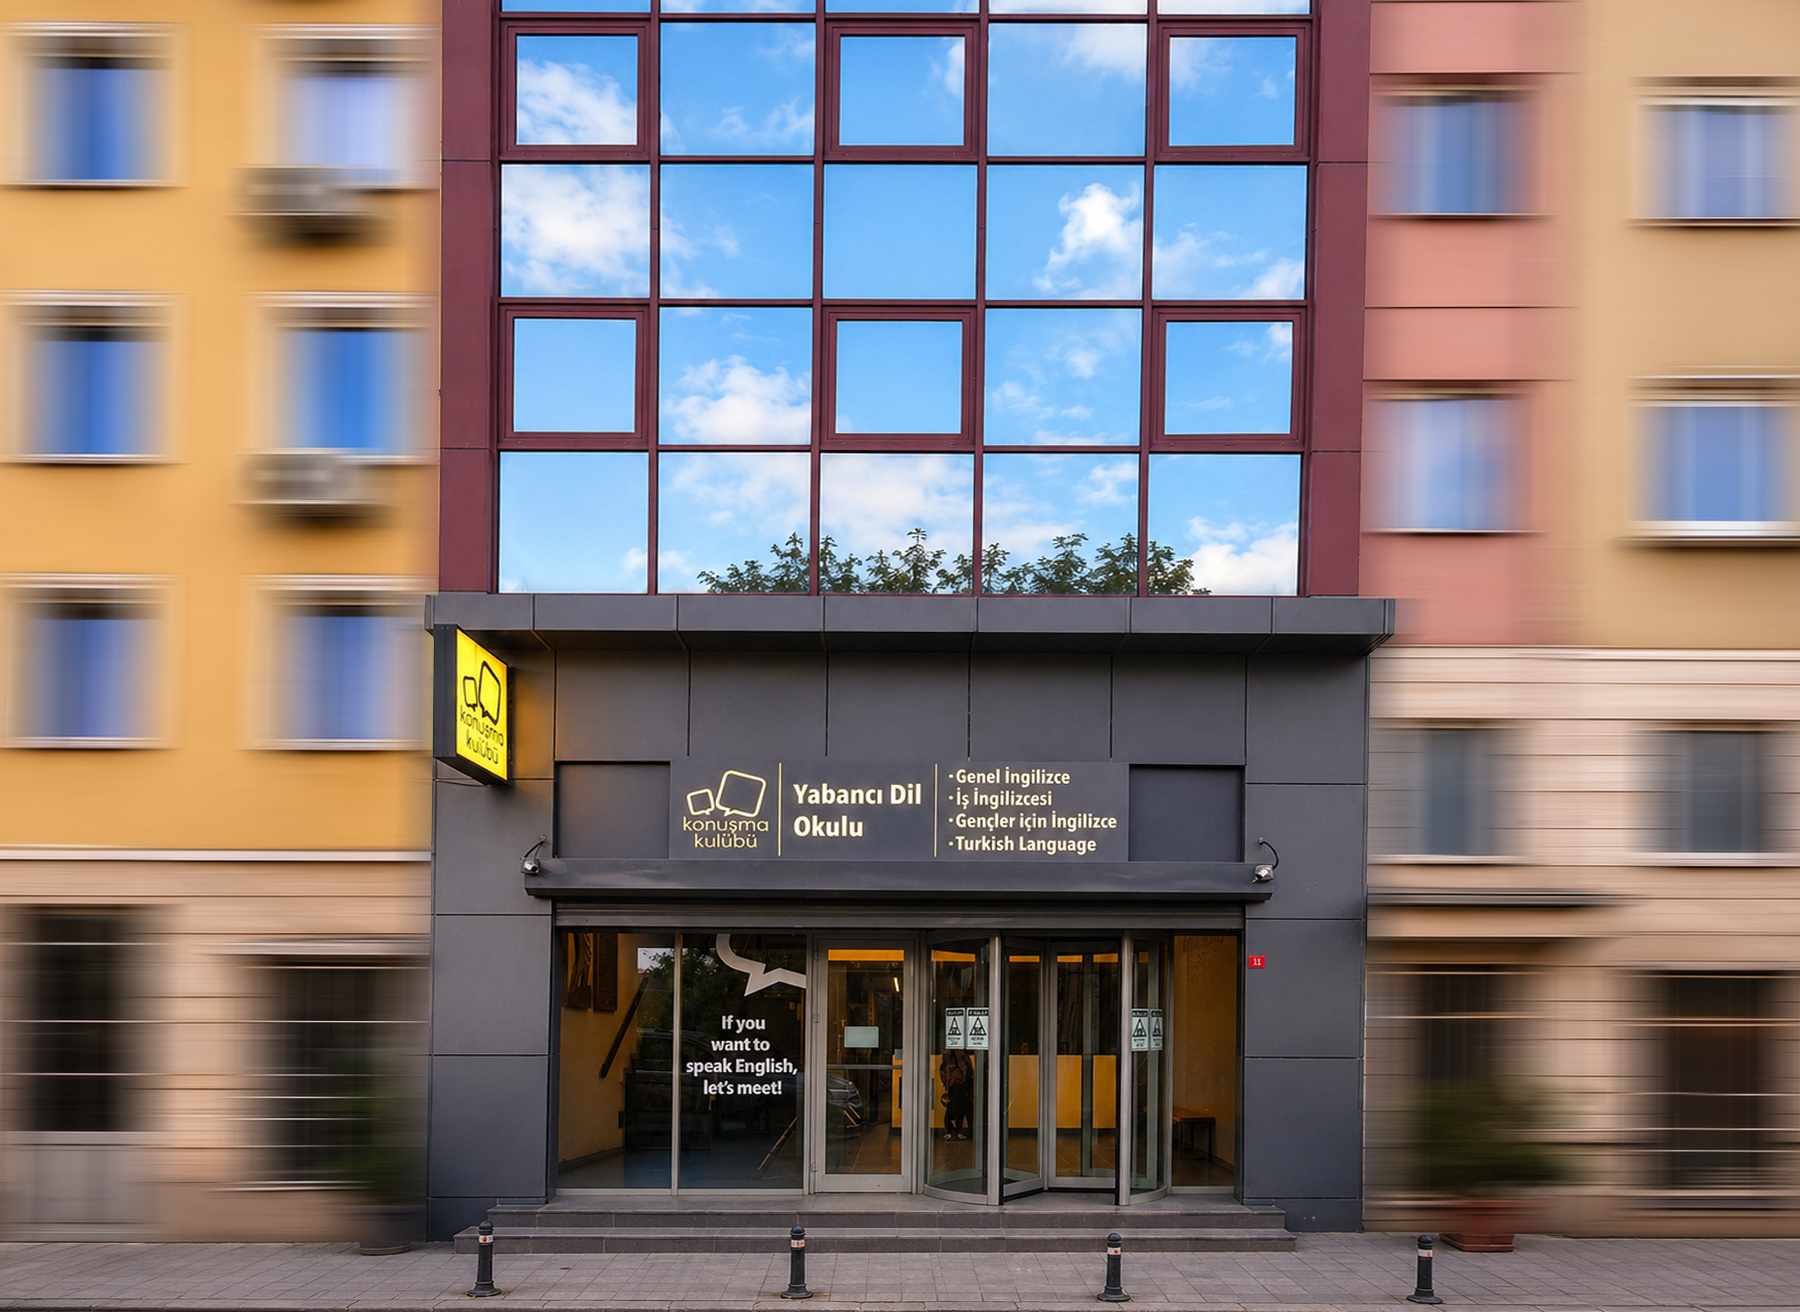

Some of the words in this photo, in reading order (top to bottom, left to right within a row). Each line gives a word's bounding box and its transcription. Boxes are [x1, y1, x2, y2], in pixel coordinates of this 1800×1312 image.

[459, 704, 504, 747] konuşma
[1005, 766, 1071, 788] İngilizce
[793, 783, 883, 805] Yabancı
[890, 783, 922, 805] Dil
[973, 787, 1052, 810] İngilizcesi
[682, 816, 769, 834] konuşma
[793, 815, 864, 837] Okulu
[1019, 812, 1047, 831] için
[1051, 810, 1118, 832] İngilizce
[694, 833, 758, 848] kulübü
[1019, 836, 1097, 855] Language
[721, 1014, 734, 1030] If
[735, 1019, 766, 1034] you
[711, 1038, 751, 1052] want
[753, 1038, 771, 1052] to
[686, 1058, 732, 1077] speak
[735, 1058, 798, 1077] English,
[737, 1080, 782, 1095] meet!
